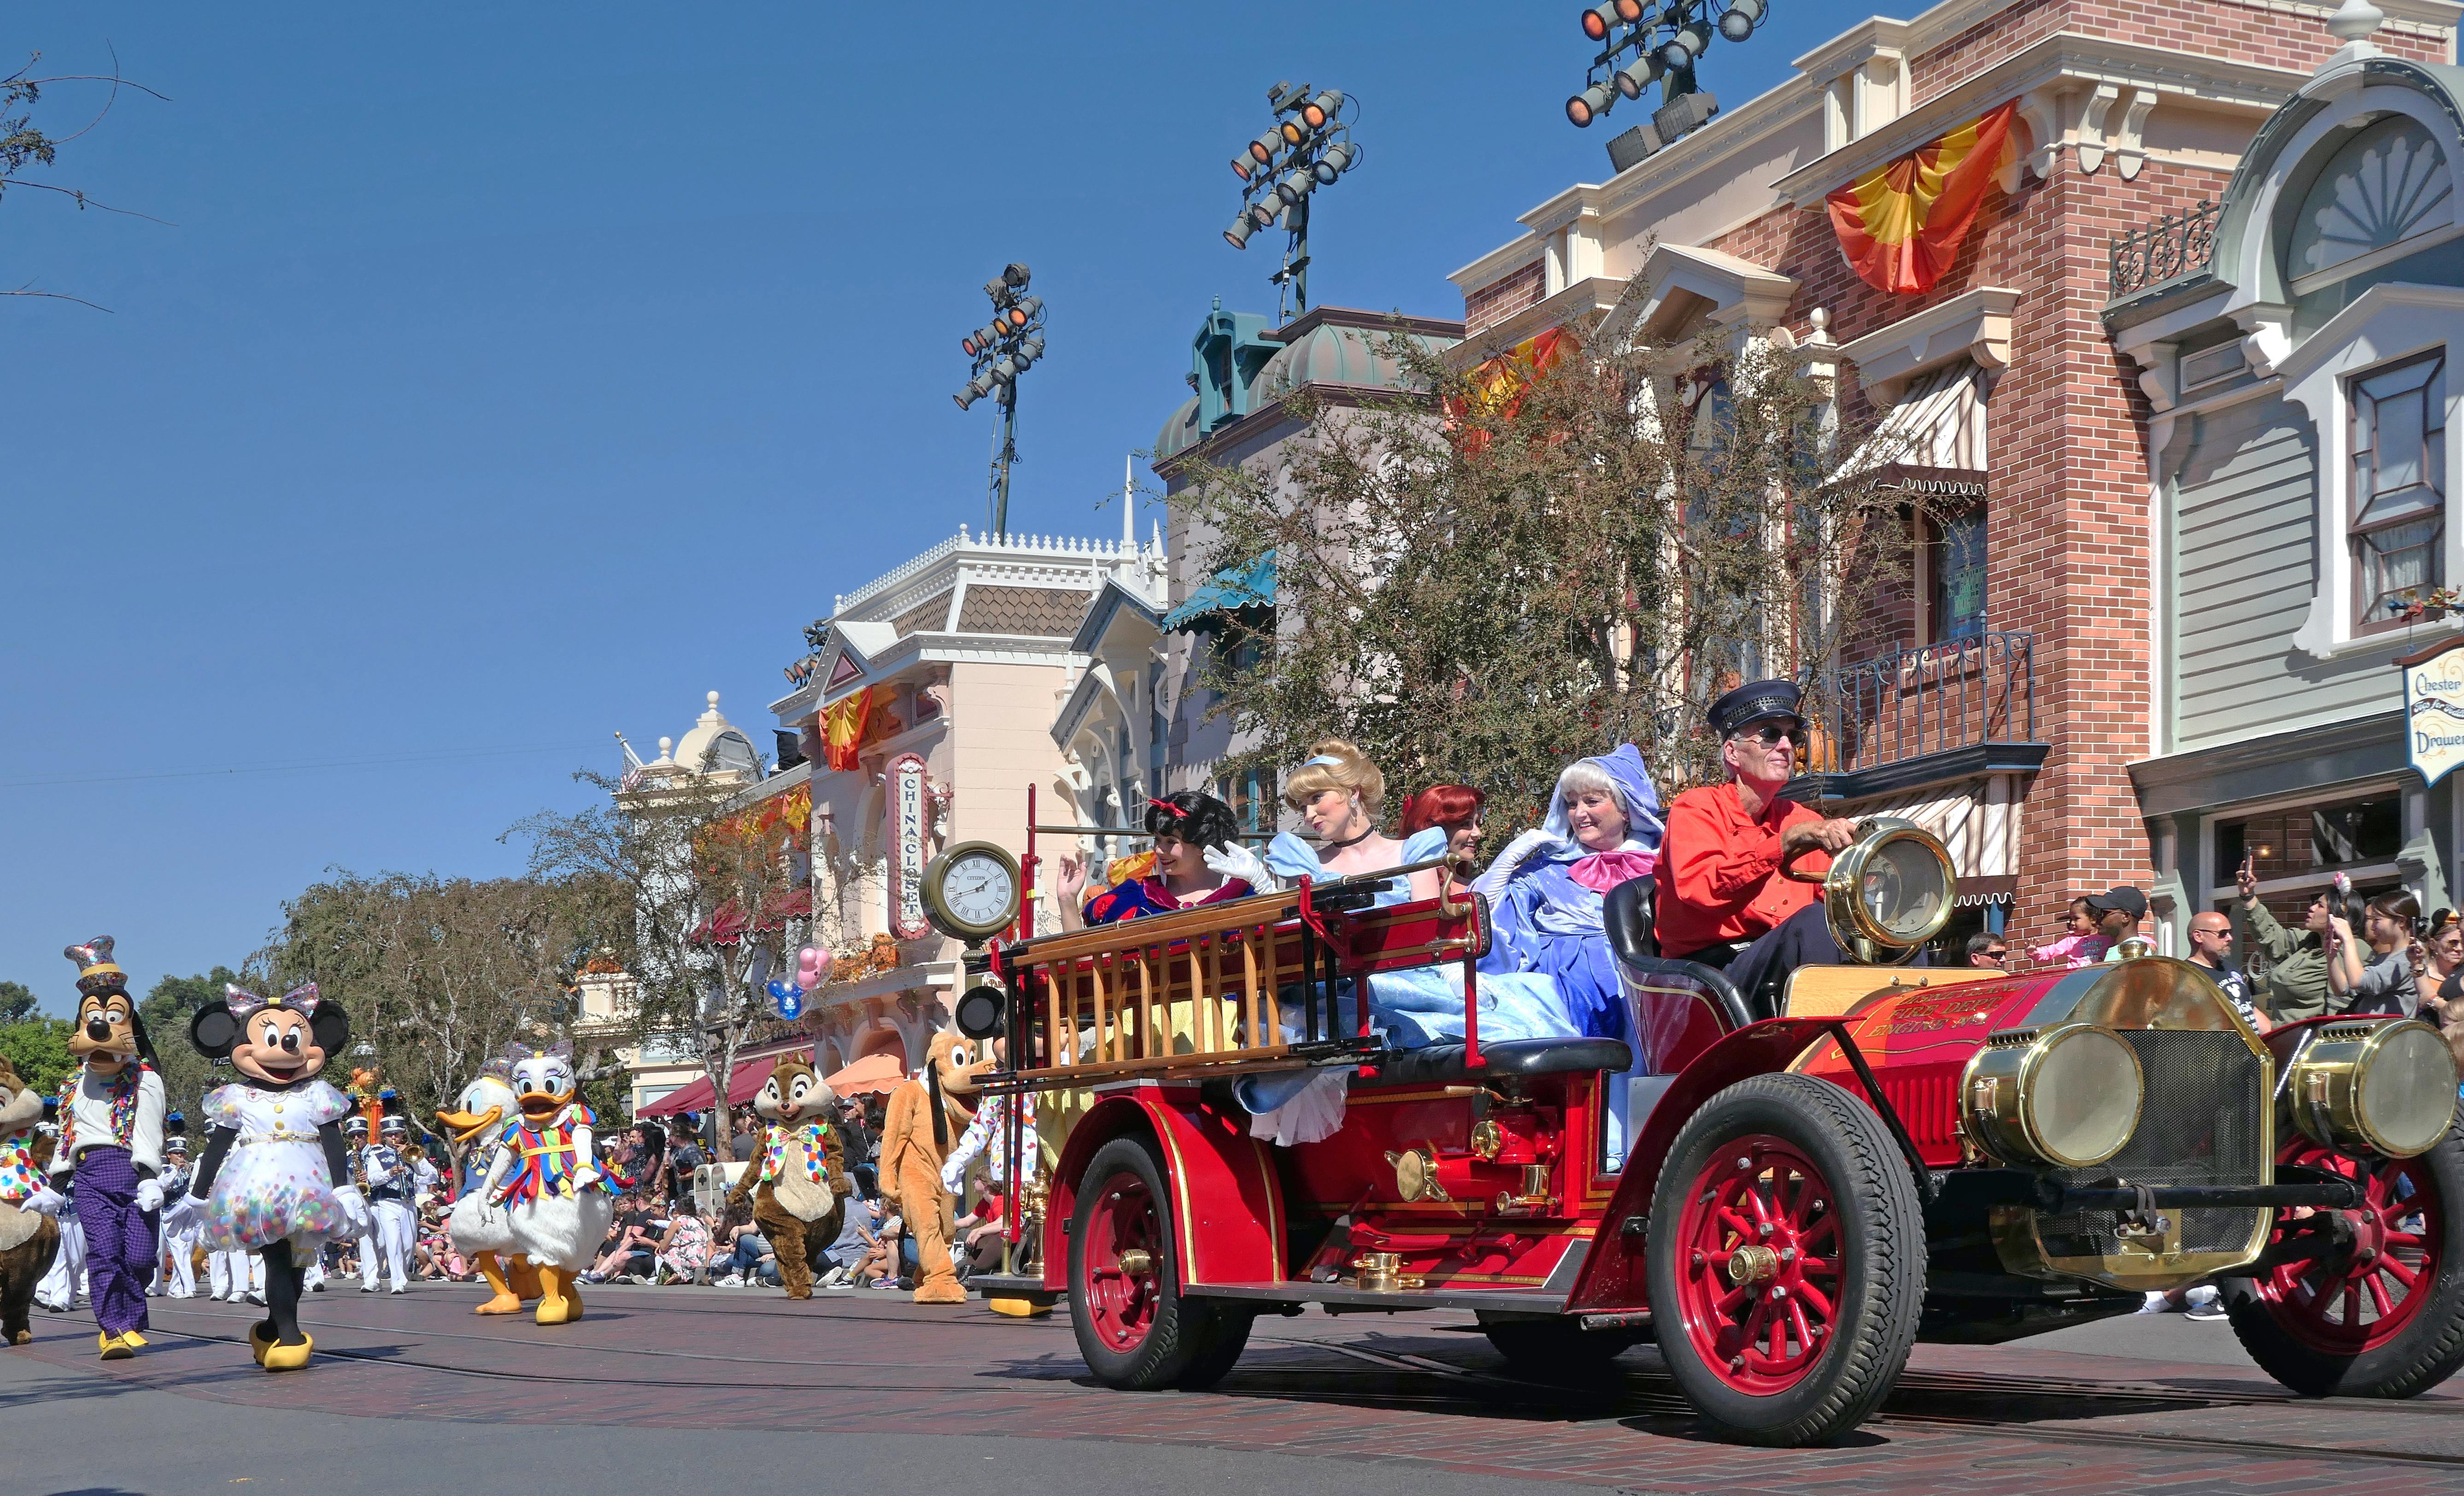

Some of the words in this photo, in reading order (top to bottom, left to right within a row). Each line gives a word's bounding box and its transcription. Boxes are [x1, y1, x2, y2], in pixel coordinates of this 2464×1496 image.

[2415, 673, 2461, 696] Chester
[2413, 700, 2430, 714] Togs
[2429, 699, 2445, 710] for
[904, 779, 918, 837] CHINA
[905, 844, 918, 914] CLOSET
[1893, 981, 2031, 1006] DISNEYLAND
[1884, 1003, 1940, 1021] FIRE
[1939, 997, 2003, 1015] DEPT.
[1866, 1017, 1949, 1038] ENGINE
